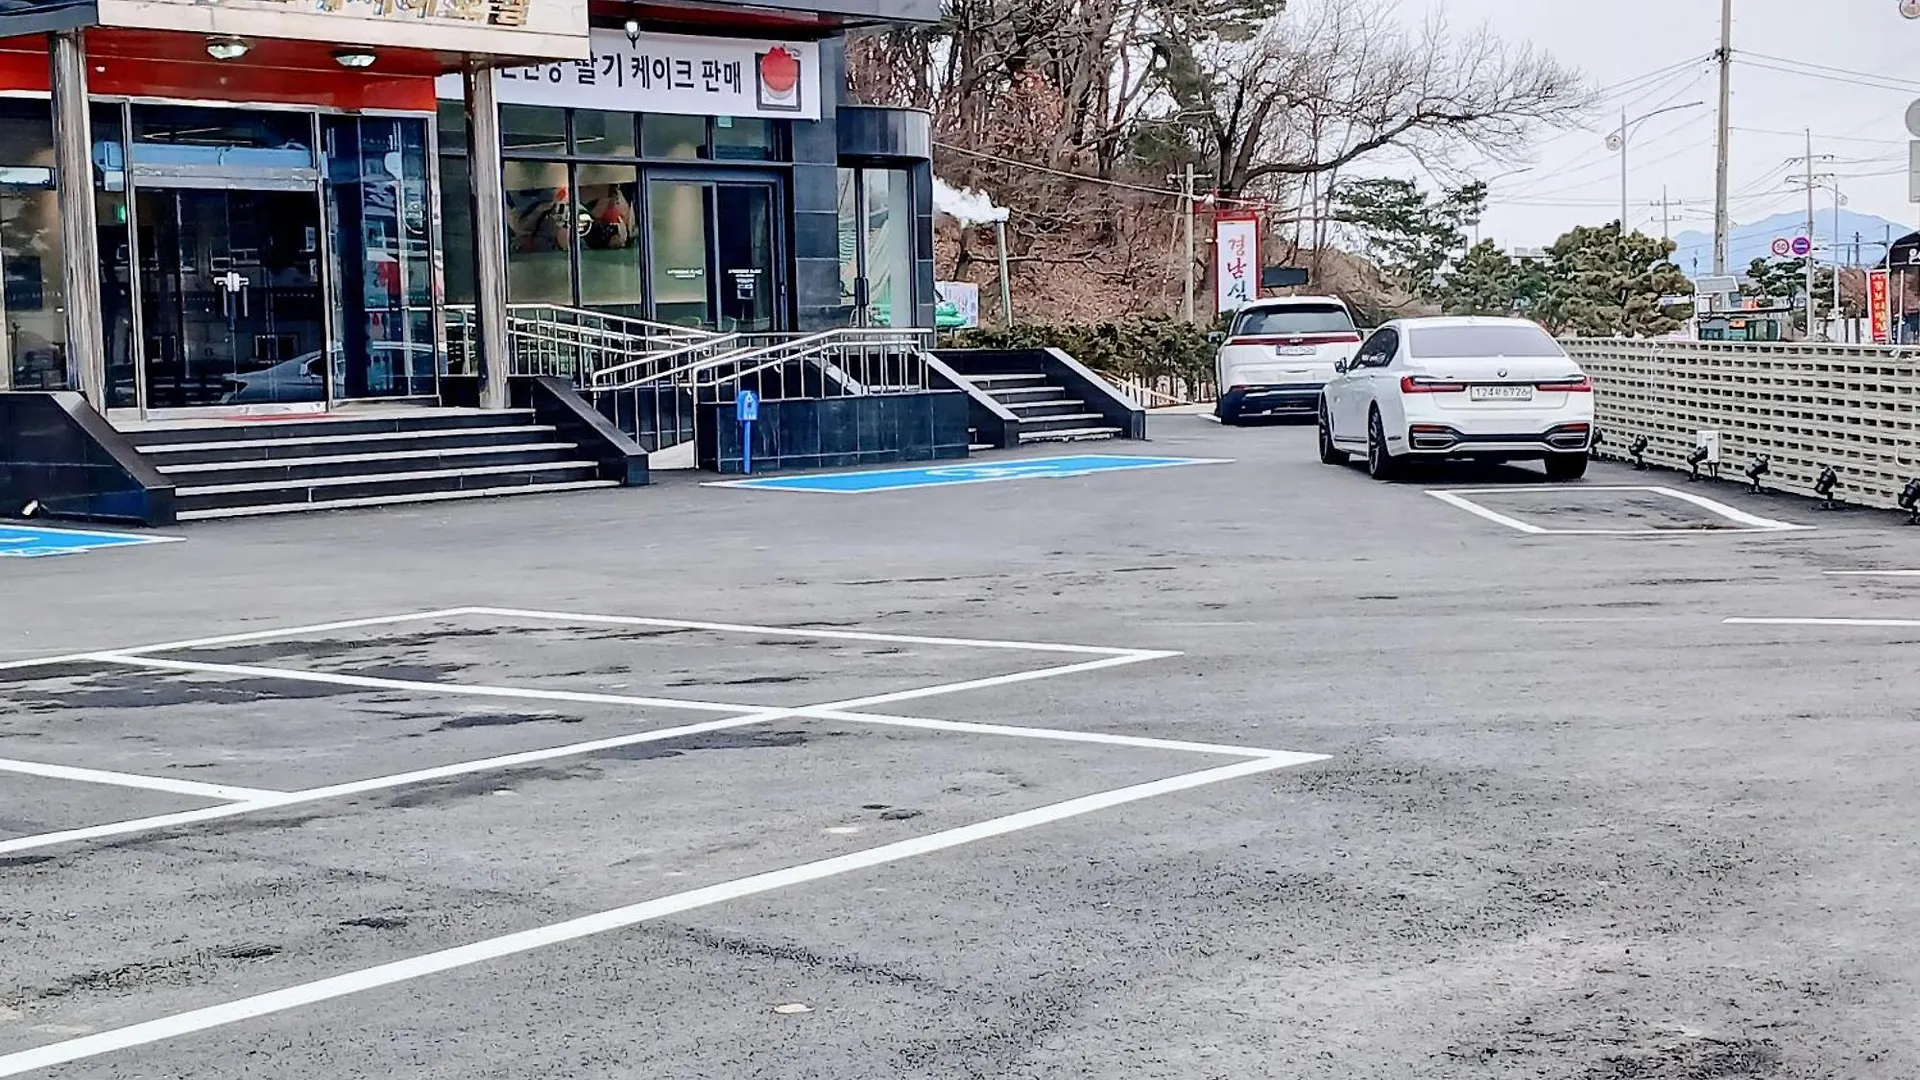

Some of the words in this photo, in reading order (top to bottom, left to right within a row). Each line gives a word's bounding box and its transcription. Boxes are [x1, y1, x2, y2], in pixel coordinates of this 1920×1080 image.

[574, 52, 623, 88] 딸기
[631, 55, 695, 90] 케이크
[702, 59, 742, 94] 판매
